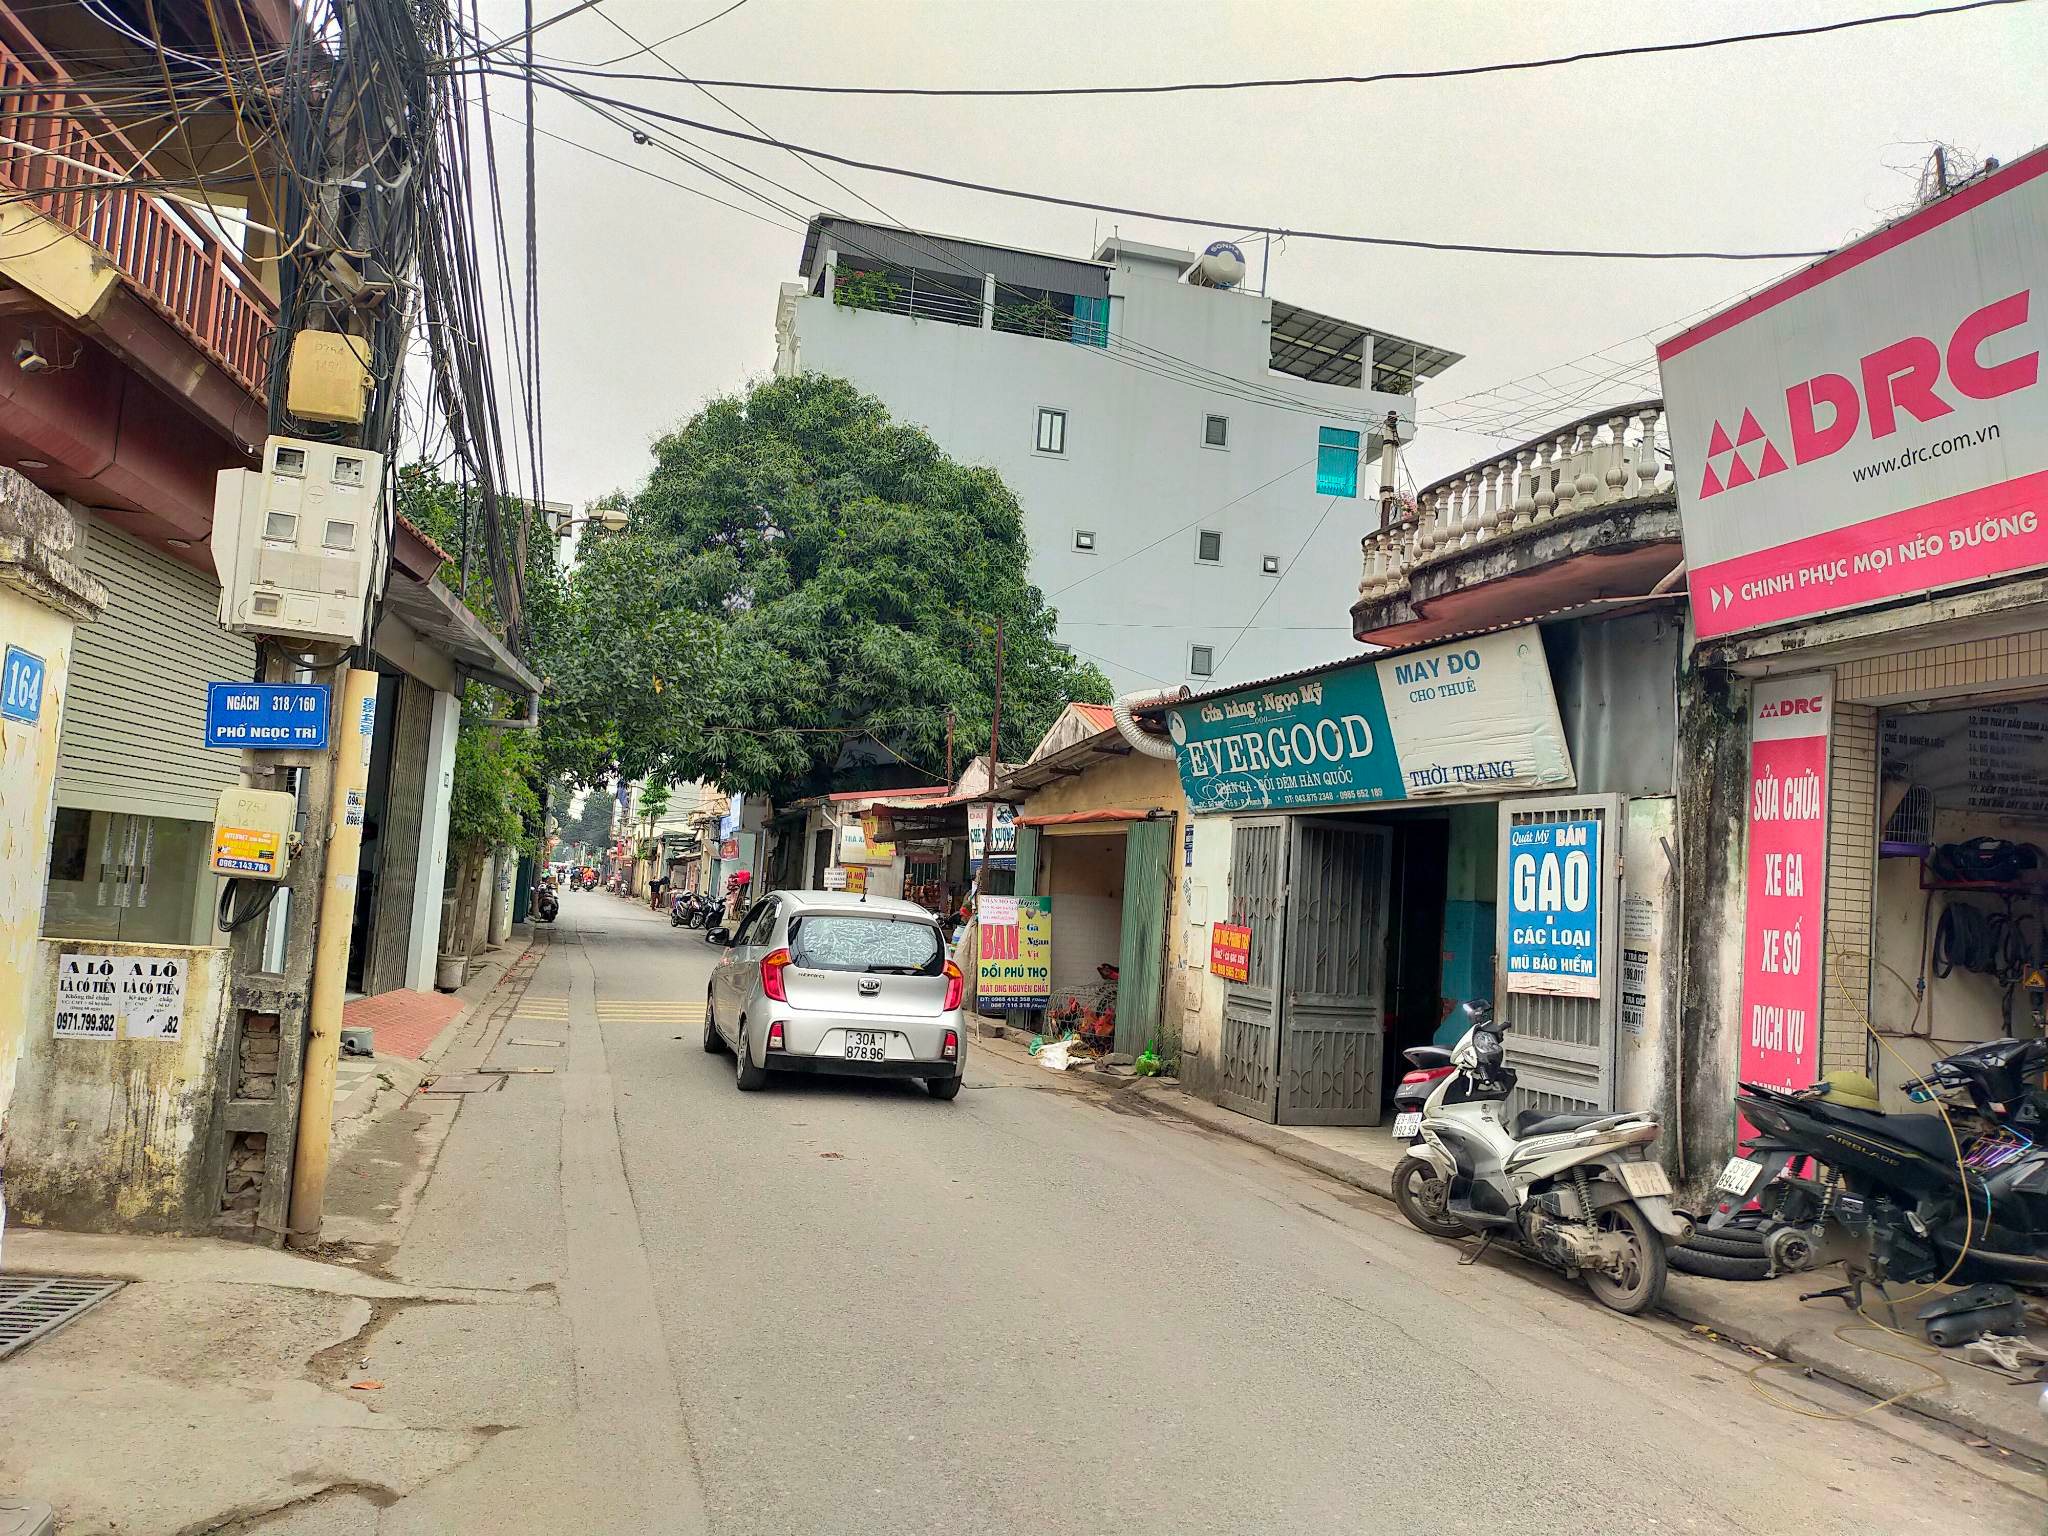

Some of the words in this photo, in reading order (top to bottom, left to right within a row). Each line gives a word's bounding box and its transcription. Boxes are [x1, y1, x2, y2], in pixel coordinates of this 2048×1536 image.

[1786, 289, 2039, 466] DRC
[1853, 424, 2000, 483] www.drc.com.vn
[1741, 572, 1795, 600] CHINH
[1799, 558, 1848, 586] PHỤC
[1854, 549, 1893, 574] MỌI
[1898, 532, 1944, 563] NẺO
[1949, 511, 2039, 551] ĐƯỜNG
[1395, 657, 1440, 685] MAY
[1447, 649, 1481, 675] ĐO
[7, 660, 41, 712] 164
[1409, 687, 1436, 703] CHO
[1438, 676, 1476, 698] THUÊ
[226, 691, 260, 711] NGÁCH
[272, 695, 316, 713] 318/160
[1201, 703, 1224, 723] Cửa
[1224, 701, 1257, 719] hàng
[1263, 693, 1299, 713] Ngọc
[1299, 682, 1323, 706] Mỹ
[1780, 696, 1823, 717] DRC
[217, 722, 247, 738] PHỐ
[250, 727, 290, 740] NGỌC
[294, 725, 317, 739] TRÌ
[1185, 715, 1374, 777] EVERGOOD
[1300, 770, 1321, 788] HÀN
[1323, 764, 1353, 786] QUỐC
[1410, 763, 1449, 787] THỜI
[1453, 760, 1515, 783] TRANG
[1754, 763, 1780, 821] SỬA
[1783, 768, 1820, 821] CHỮA
[1555, 824, 1587, 847] BÁN
[1765, 853, 1782, 897] XE
[1785, 853, 1804, 897] GA
[1513, 850, 1590, 925] GẠO
[1027, 936, 1049, 947] Ngan
[1513, 926, 1546, 945] CÁC
[1551, 929, 1591, 949] LOẠI
[1761, 929, 1780, 973] XE
[1782, 916, 1803, 976] SỐ
[62, 961, 79, 973] A
[86, 960, 114, 976] LÔ
[129, 963, 143, 975] A
[150, 961, 178, 977] LÔ
[981, 962, 1001, 978] ĐỒI
[1004, 964, 1024, 978] PHÚ
[1027, 967, 1048, 981] THỌ
[1511, 954, 1529, 970] MŨ
[1532, 952, 1557, 970] BẢO
[1561, 953, 1593, 974] HIỂM
[61, 976, 73, 991] LÀ
[77, 977, 90, 992] CÓ
[93, 976, 116, 993] TIỀN
[123, 978, 137, 993] LÀ
[140, 979, 154, 994] CÓ
[863, 981, 877, 989] KIA
[56, 1012, 114, 1032] 0971.799.382
[855, 1033, 876, 1046] 30A
[1752, 1004, 1784, 1059] DỊCH
[1786, 1009, 1805, 1065] VỤ
[846, 1046, 884, 1060] 878.96
